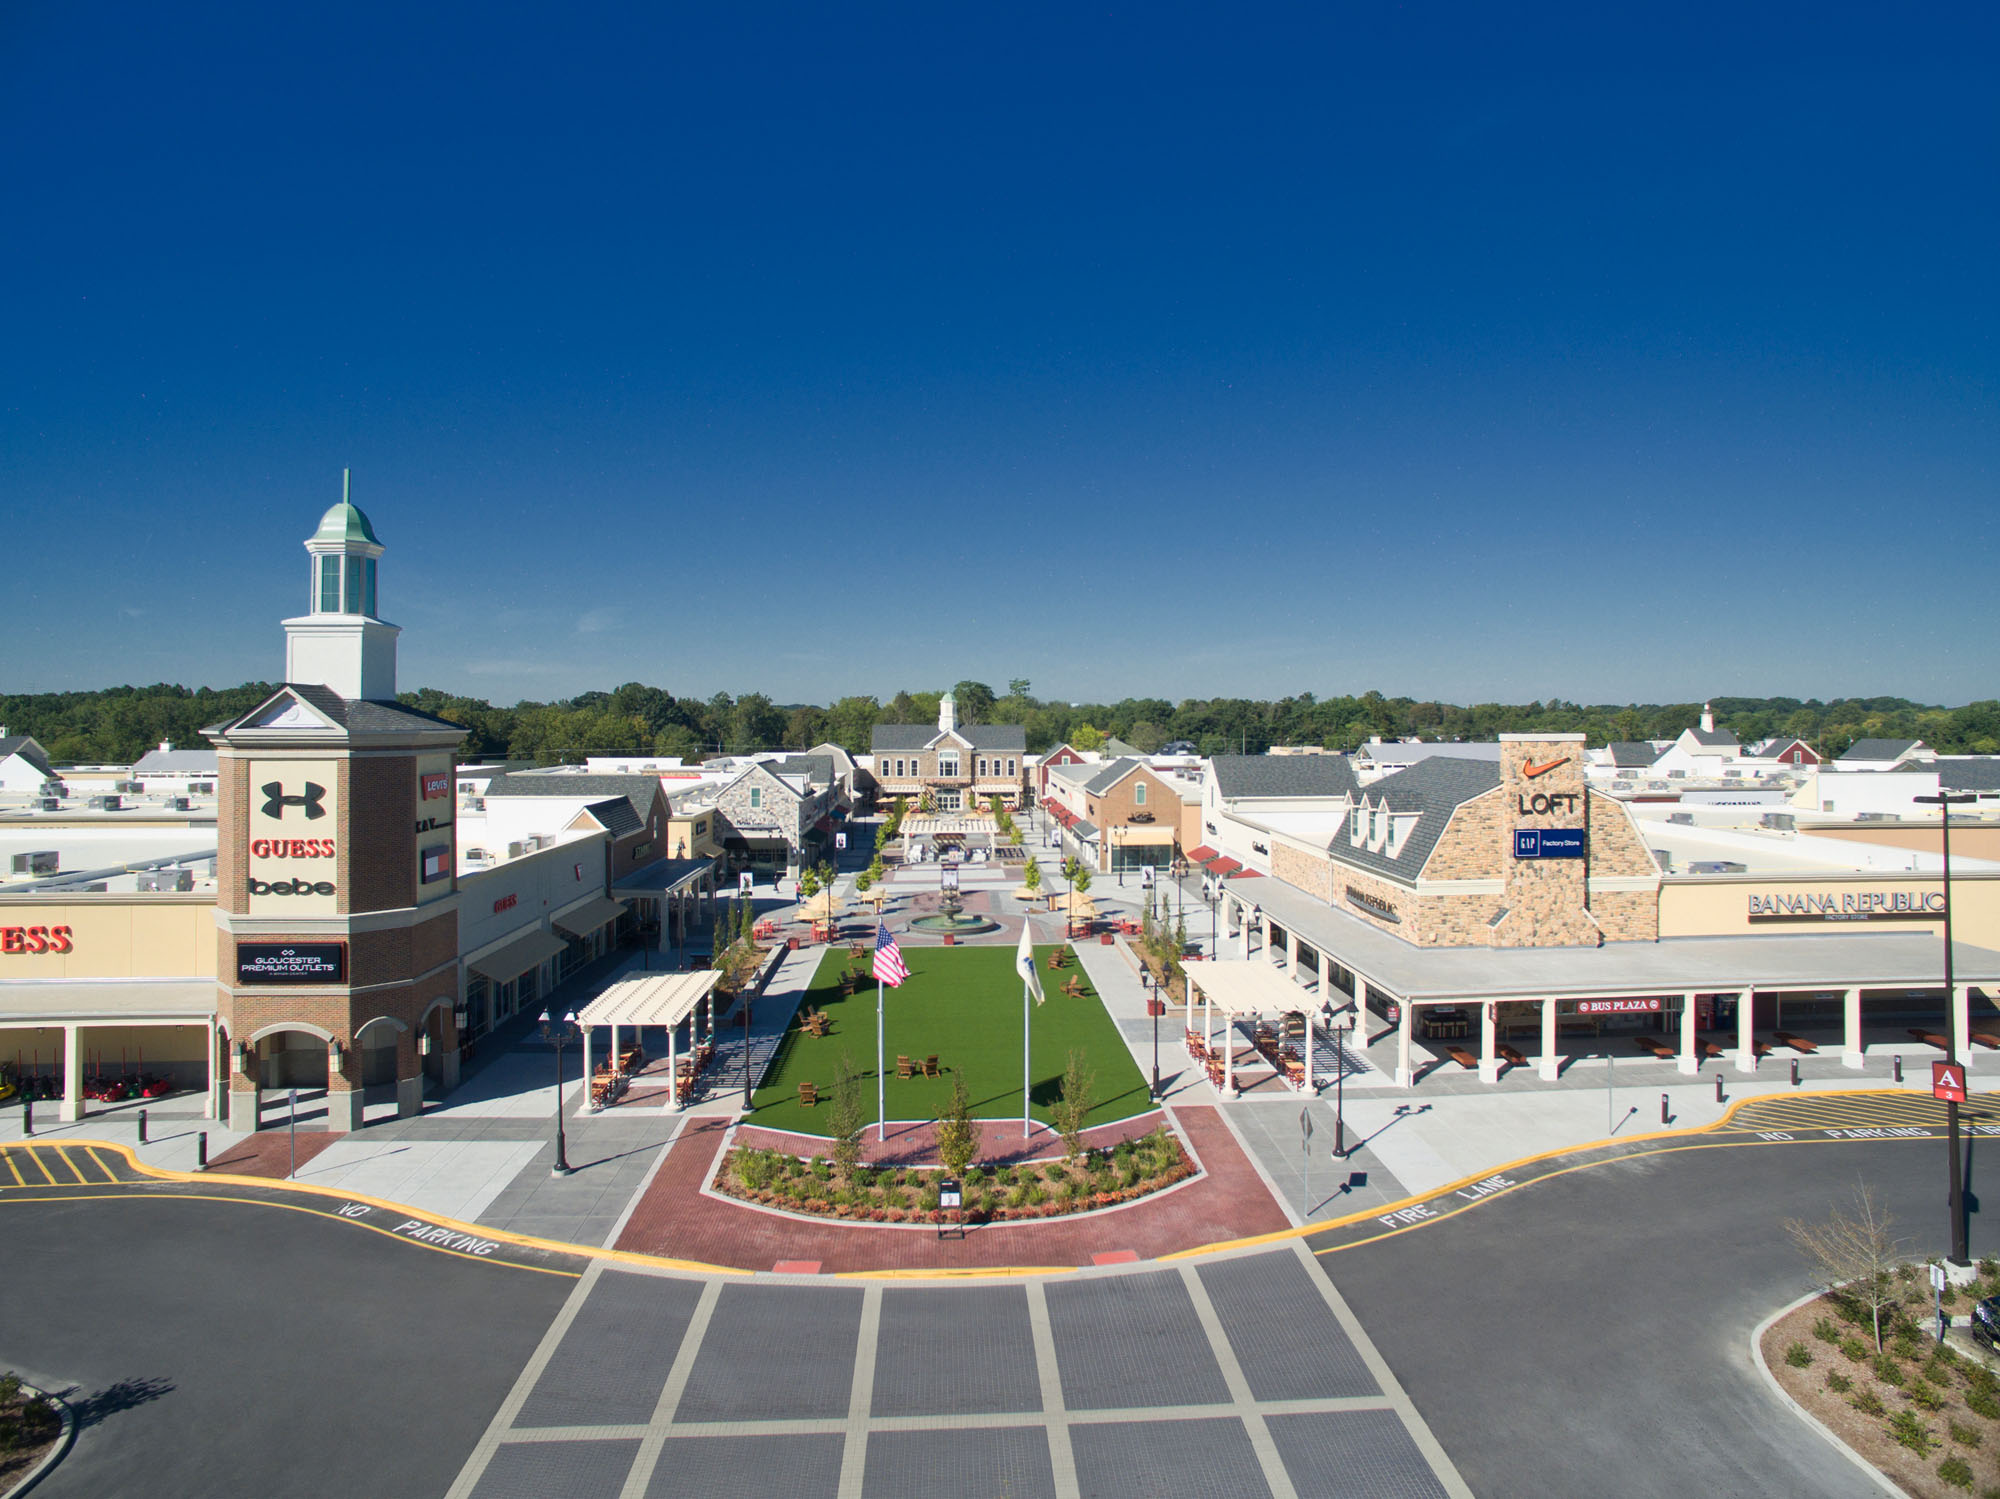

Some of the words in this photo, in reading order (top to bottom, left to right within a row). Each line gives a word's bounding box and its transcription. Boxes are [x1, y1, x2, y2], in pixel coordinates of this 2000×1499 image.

[1518, 793, 1579, 815] LOFT
[251, 839, 336, 858] GUESS
[1520, 837, 1535, 849] GAP
[1542, 839, 1564, 848] Factory
[1564, 839, 1581, 847] Store
[248, 877, 337, 896] bebe
[1749, 894, 1839, 914] BANANA
[1842, 892, 1945, 912] REPUBLIC
[1590, 1003, 1611, 1011] BUS
[1613, 1001, 1647, 1010] PLAZA
[1937, 1069, 1960, 1088] A
[1945, 1091, 1953, 1099] 3
[1755, 1131, 1795, 1141] NO
[1823, 1127, 1932, 1139] PARKING
[1378, 1203, 1438, 1229] FIRE
[1456, 1175, 1516, 1200] LANE
[334, 1202, 372, 1217] NO
[392, 1219, 499, 1255] PARKING
